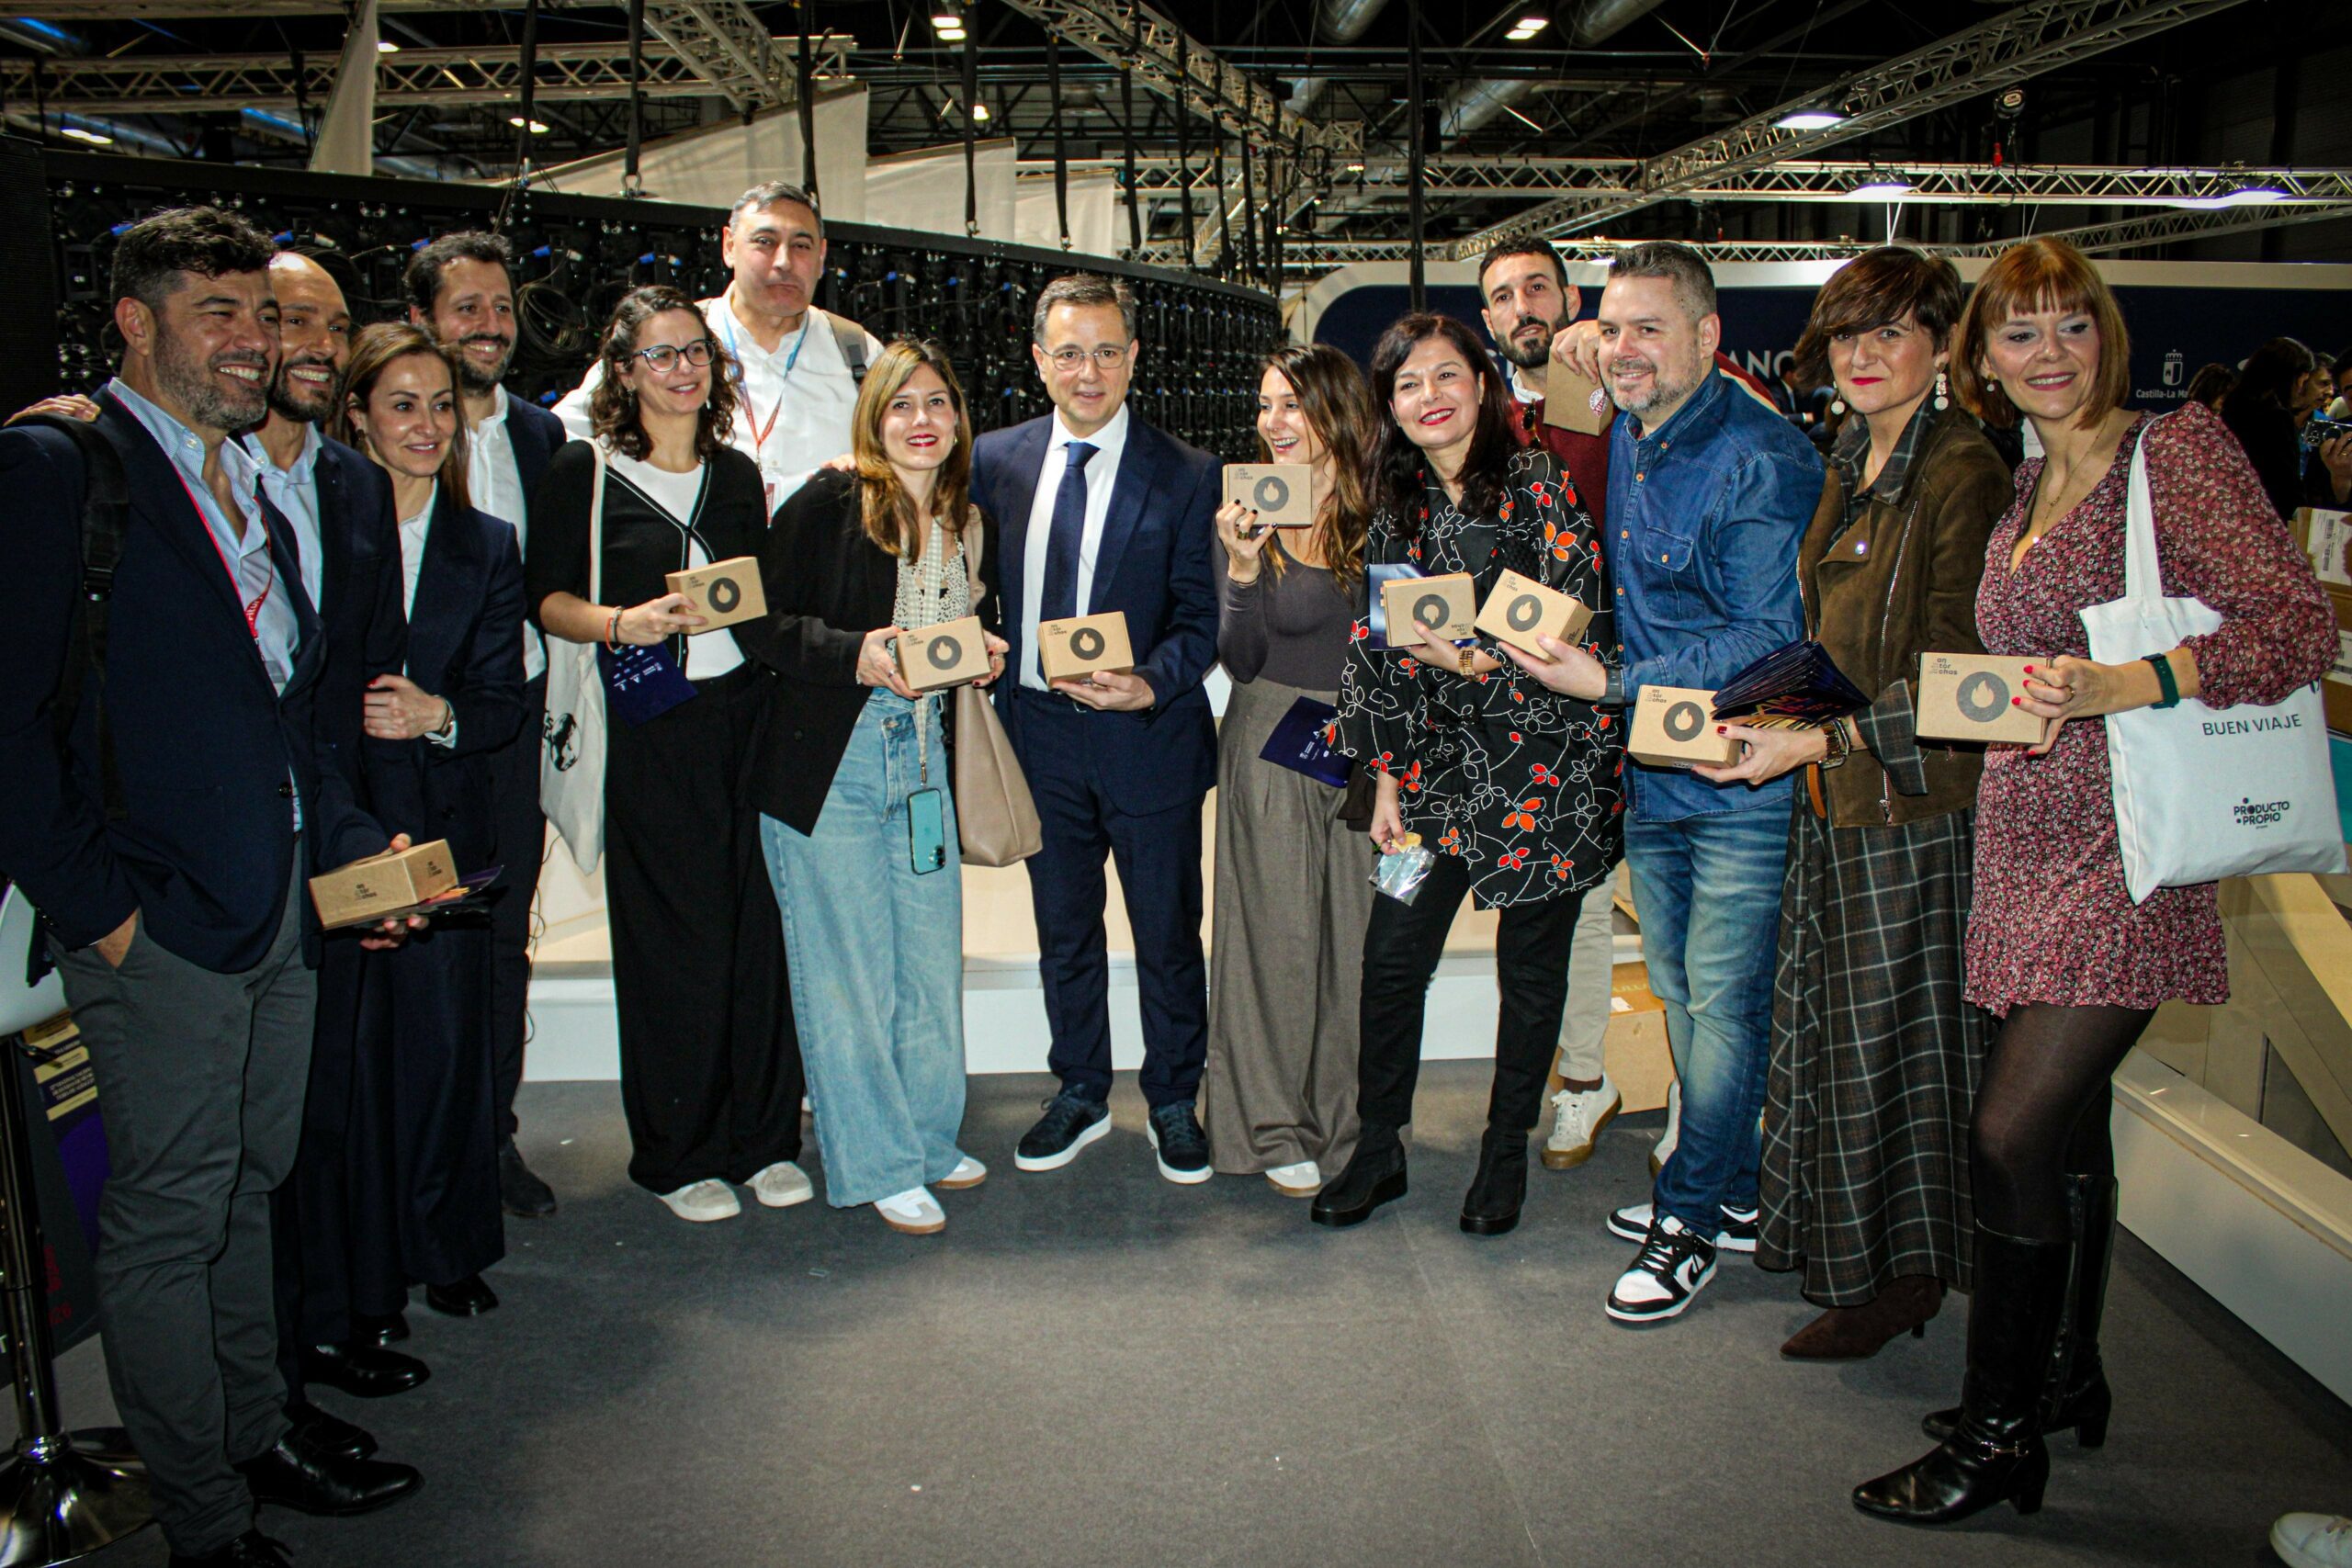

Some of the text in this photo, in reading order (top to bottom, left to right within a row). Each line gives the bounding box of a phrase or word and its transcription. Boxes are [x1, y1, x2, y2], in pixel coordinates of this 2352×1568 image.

[2136, 389, 2176, 398] Castilla-La
[2202, 714, 2301, 736] BUEN VIAJE
[2233, 801, 2290, 816] PRODUCTO
[2243, 812, 2281, 826] PROPIO
